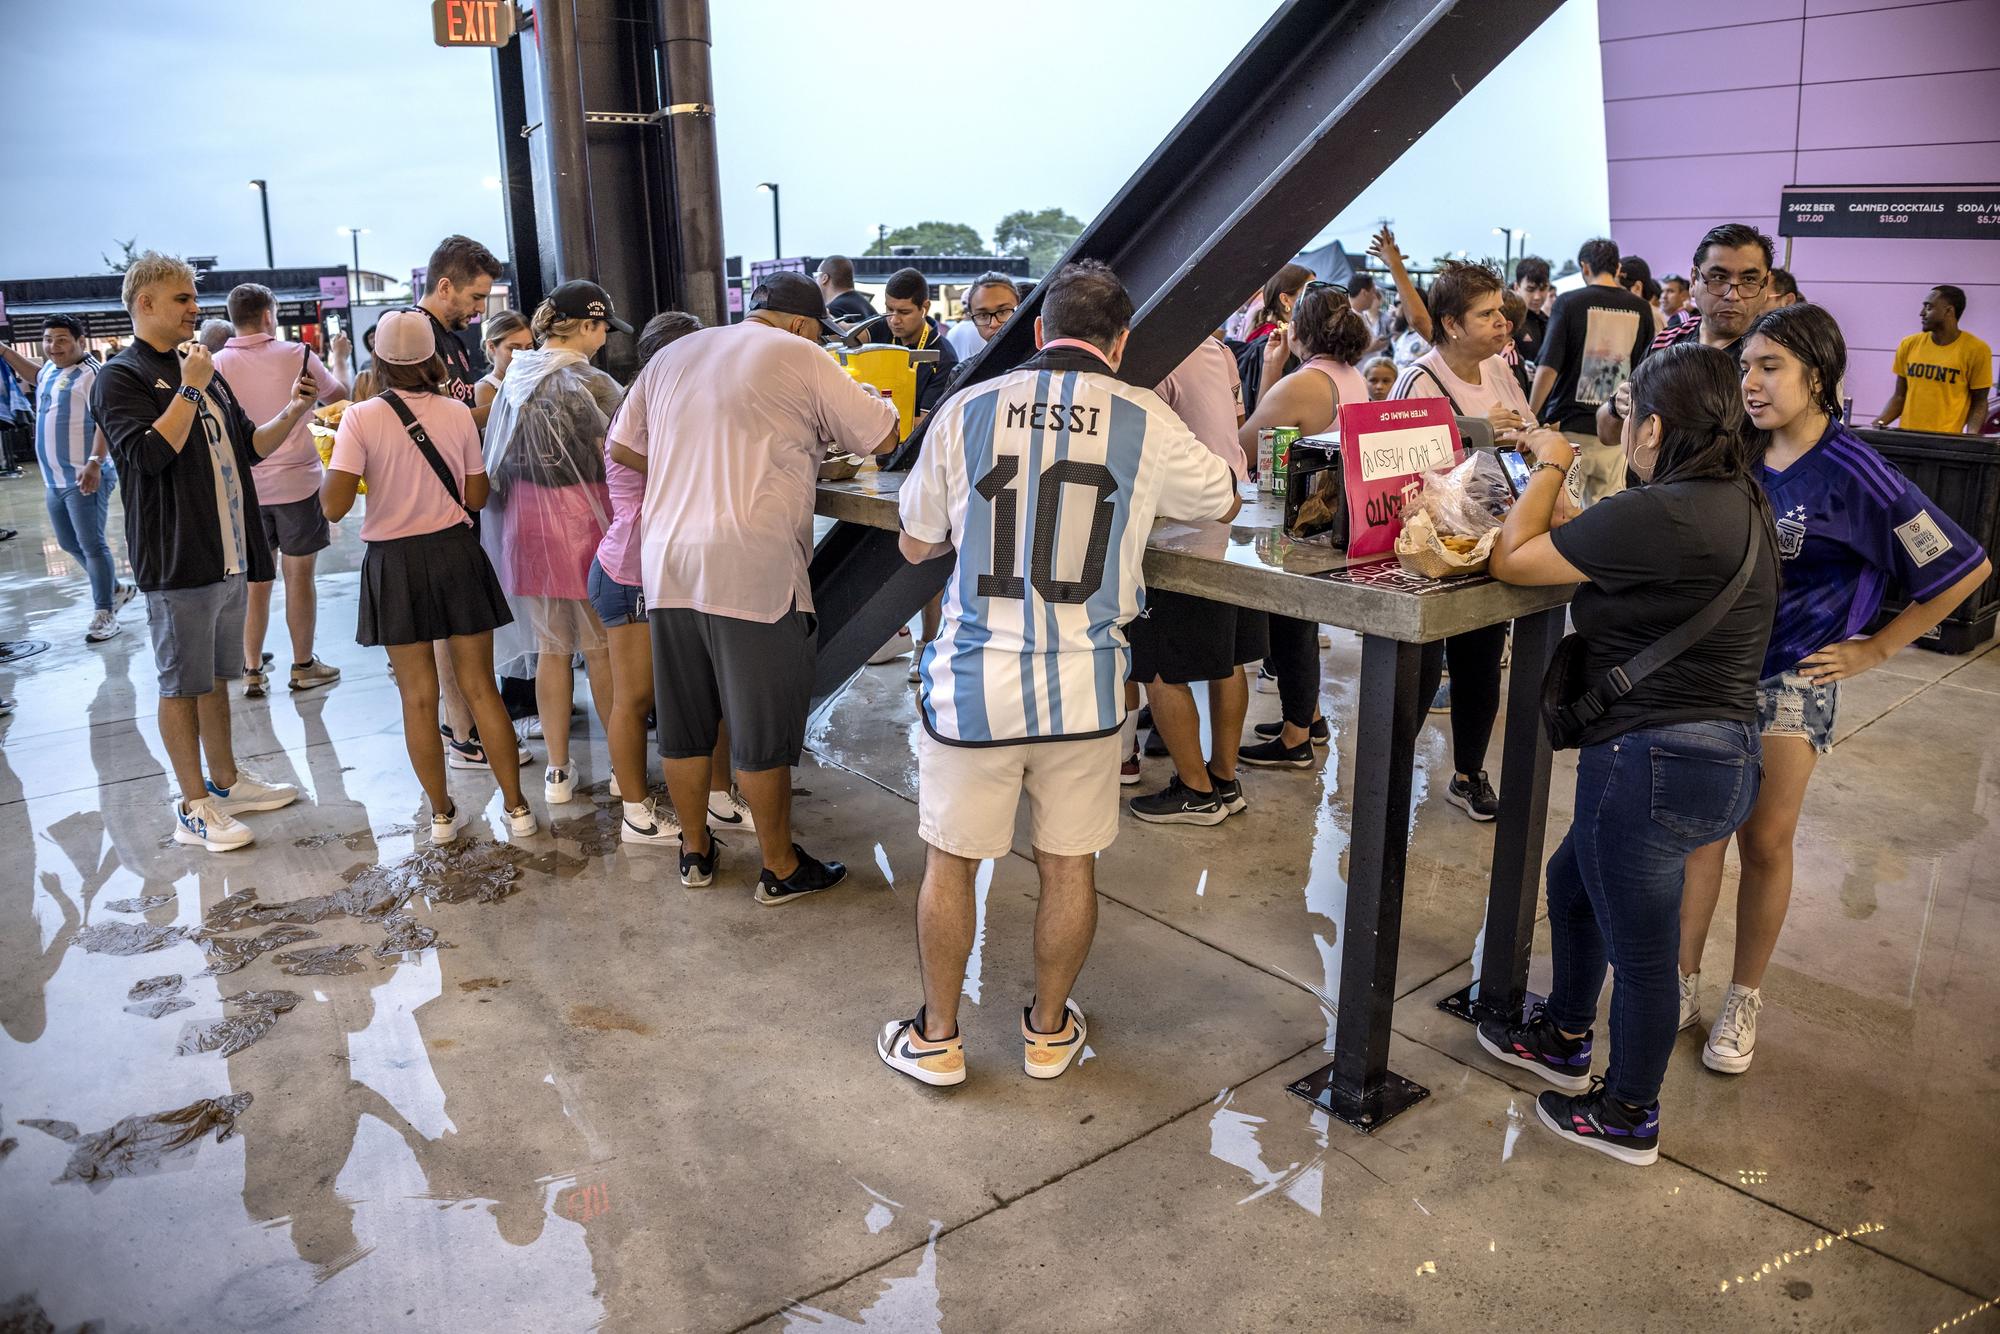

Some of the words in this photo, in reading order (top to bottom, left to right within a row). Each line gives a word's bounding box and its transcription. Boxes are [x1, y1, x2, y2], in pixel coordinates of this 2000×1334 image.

[446, 0, 498, 42] EXIT
[1813, 203, 1836, 213] BEER
[1848, 203, 1889, 213] CANNED
[1890, 203, 1945, 213] COCKTAILS
[1956, 203, 1985, 214] SODA
[1796, 214, 1825, 223] $17.00
[1879, 214, 1909, 223] $15.00
[1906, 362, 1961, 385] MOUNT
[1006, 401, 1101, 436] MESSI
[1380, 412, 1390, 421] CF
[1390, 410, 1410, 420] MIAMI
[1410, 409, 1429, 418] INTER
[1408, 443, 1432, 472] AMO
[1430, 435, 1454, 465] TE
[1373, 447, 1405, 473] MESSI
[974, 454, 1119, 605] 10
[1587, 1113, 1605, 1135] Reebok
